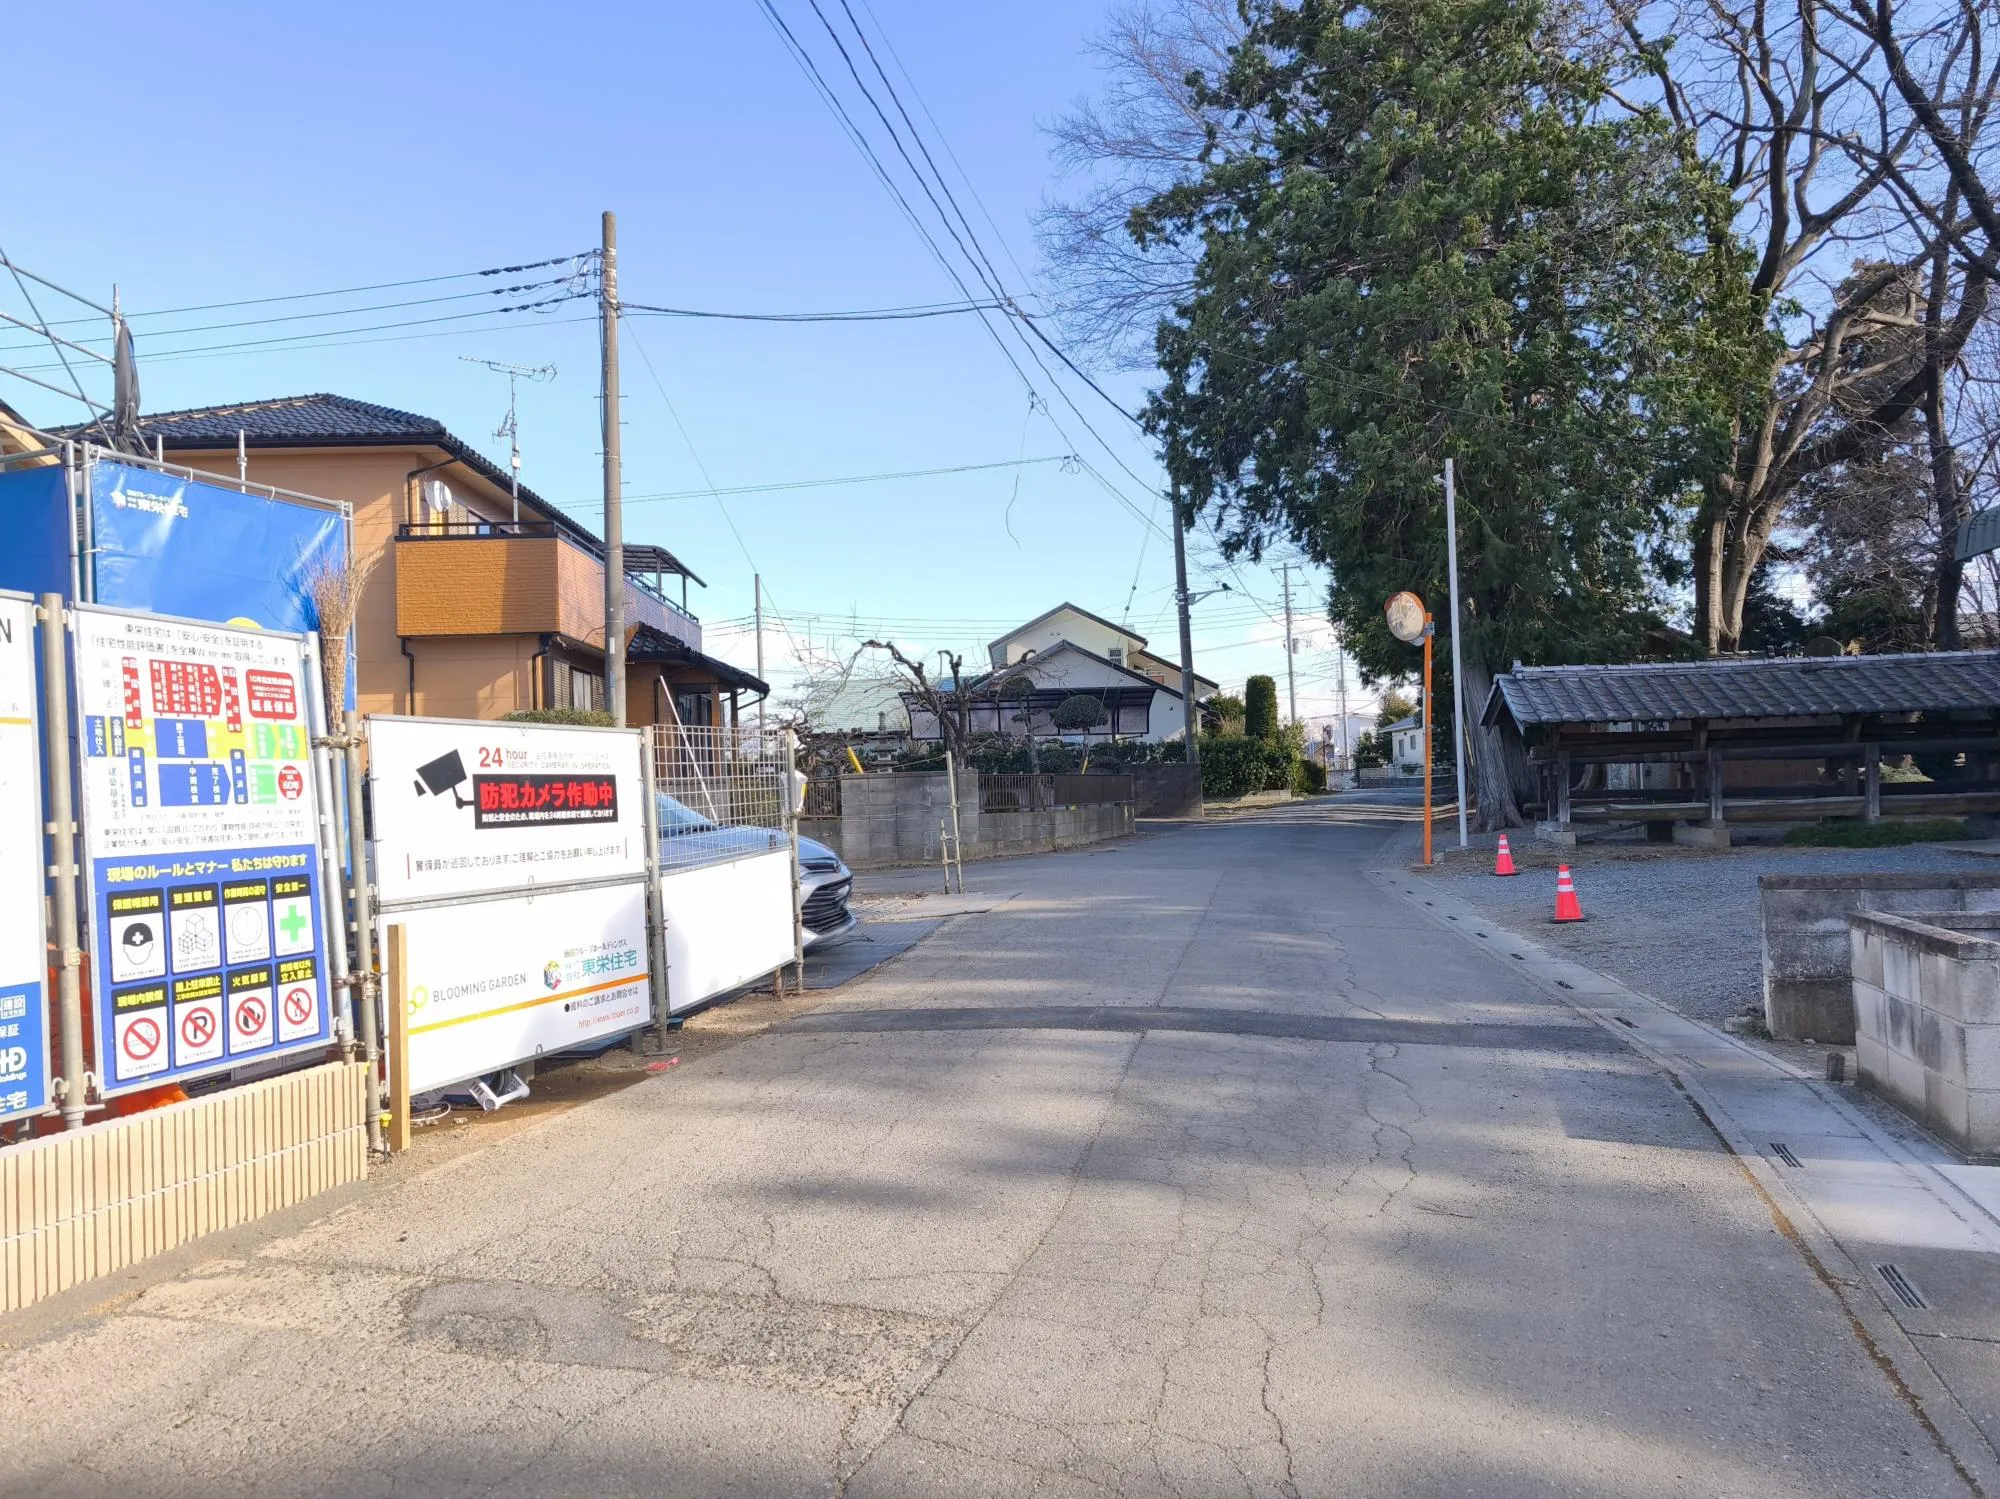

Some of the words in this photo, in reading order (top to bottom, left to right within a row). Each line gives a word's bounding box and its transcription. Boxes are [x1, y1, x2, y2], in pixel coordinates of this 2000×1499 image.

[94, 718, 104, 755] 土地仕入
[478, 746, 503, 768] 24
[506, 747, 528, 760] hour
[479, 781, 613, 810] 防犯カメラ作動中
[106, 861, 228, 883] 現場のルールとマナー
[231, 854, 307, 872] 私たちは守ります
[275, 881, 306, 894] 安全第一
[281, 970, 312, 983] 立入禁止
[582, 948, 638, 977] 東栄住宅
[232, 972, 268, 988] 火気厳禁
[432, 980, 486, 1003] BLOOMING
[488, 971, 528, 991] GARDEN
